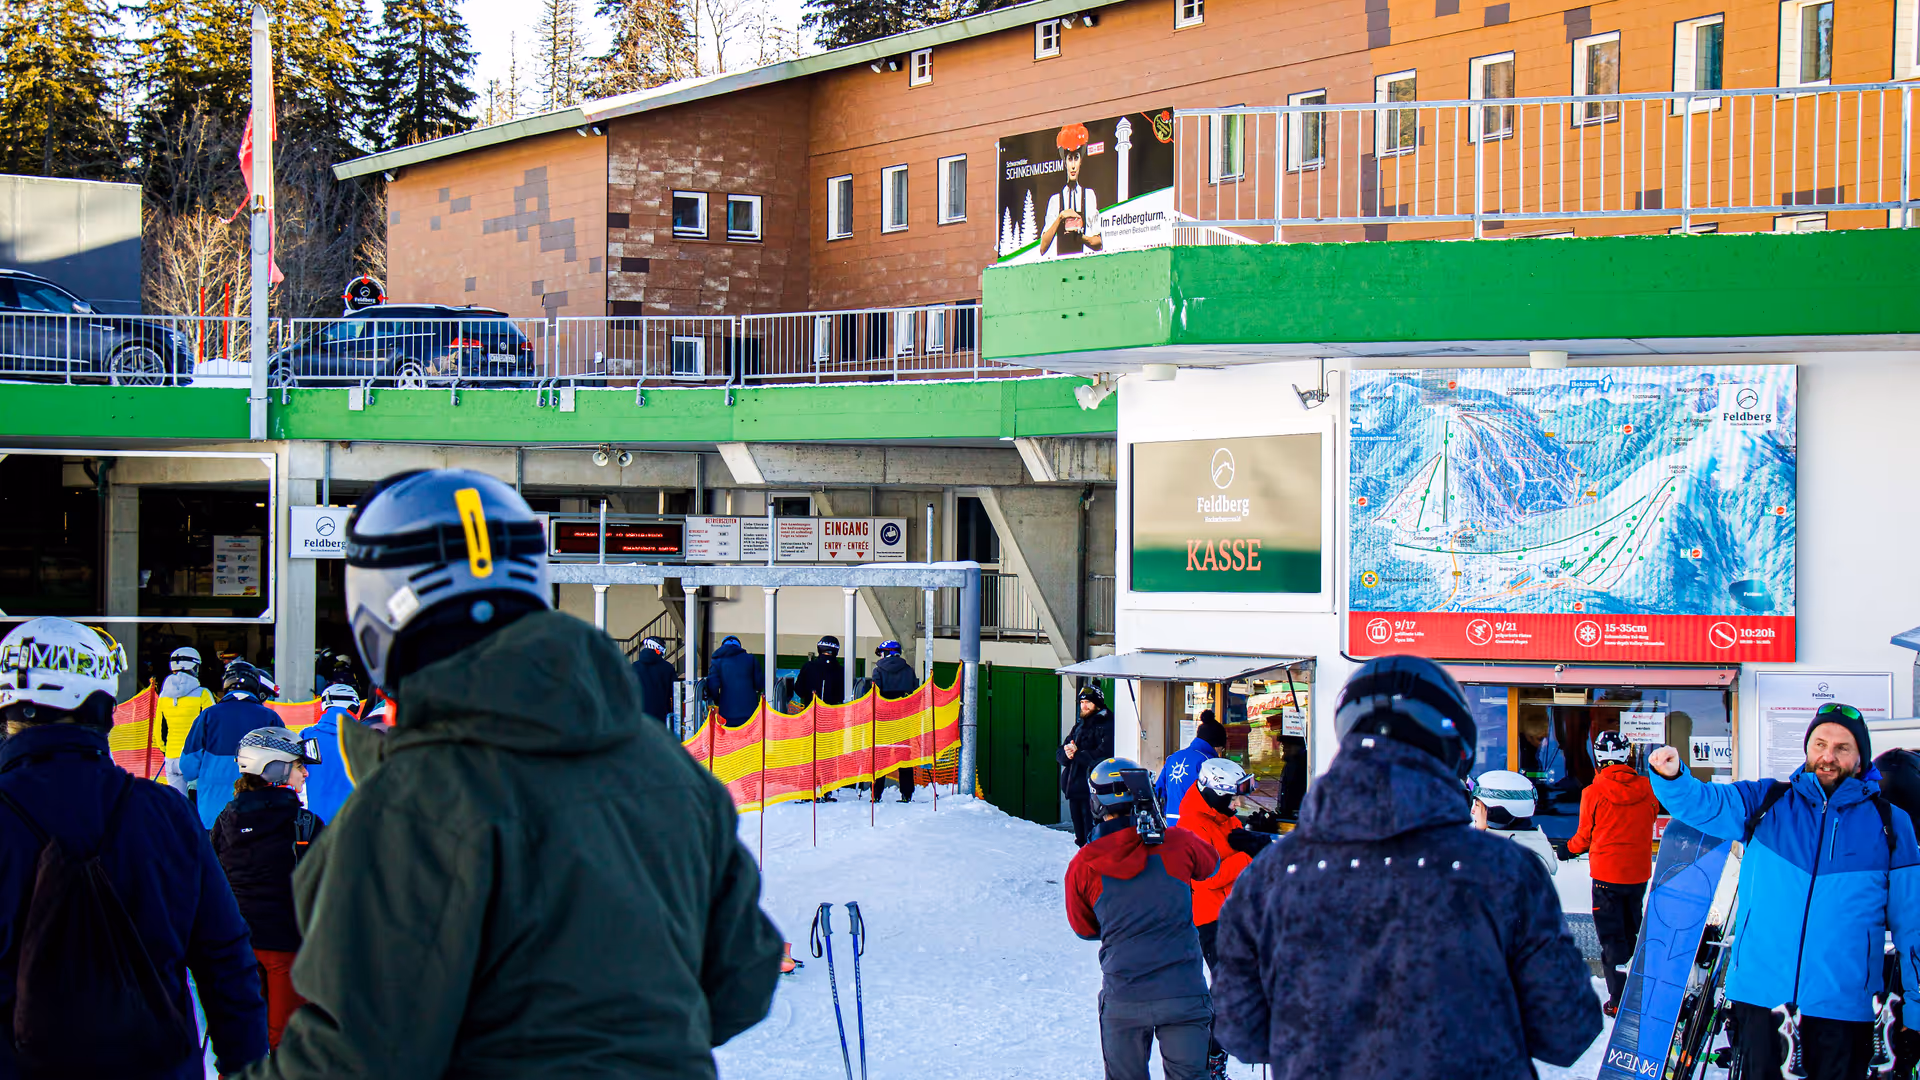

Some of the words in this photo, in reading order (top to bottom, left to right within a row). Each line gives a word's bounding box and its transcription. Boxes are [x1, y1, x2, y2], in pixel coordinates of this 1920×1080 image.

[1006, 160, 1064, 181] SCHINKENMUSEUM
[1100, 217, 1110, 228] Im
[1132, 226, 1149, 235] Besuch
[1723, 412, 1772, 423] Feldberg
[1197, 495, 1250, 517] Feldberg
[825, 521, 869, 537] EINGANG
[304, 538, 346, 551] Feldberg
[825, 542, 842, 550] ENTRY
[848, 541, 869, 551] ENTRÉE
[1186, 538, 1262, 571] KASSE
[1395, 619, 1416, 631] 9/17
[1495, 621, 1517, 632] 9/21
[1605, 624, 1647, 633] 15-35cm
[1740, 628, 1776, 638] 10:20h
[1607, 1048, 1659, 1078] PANTERA
